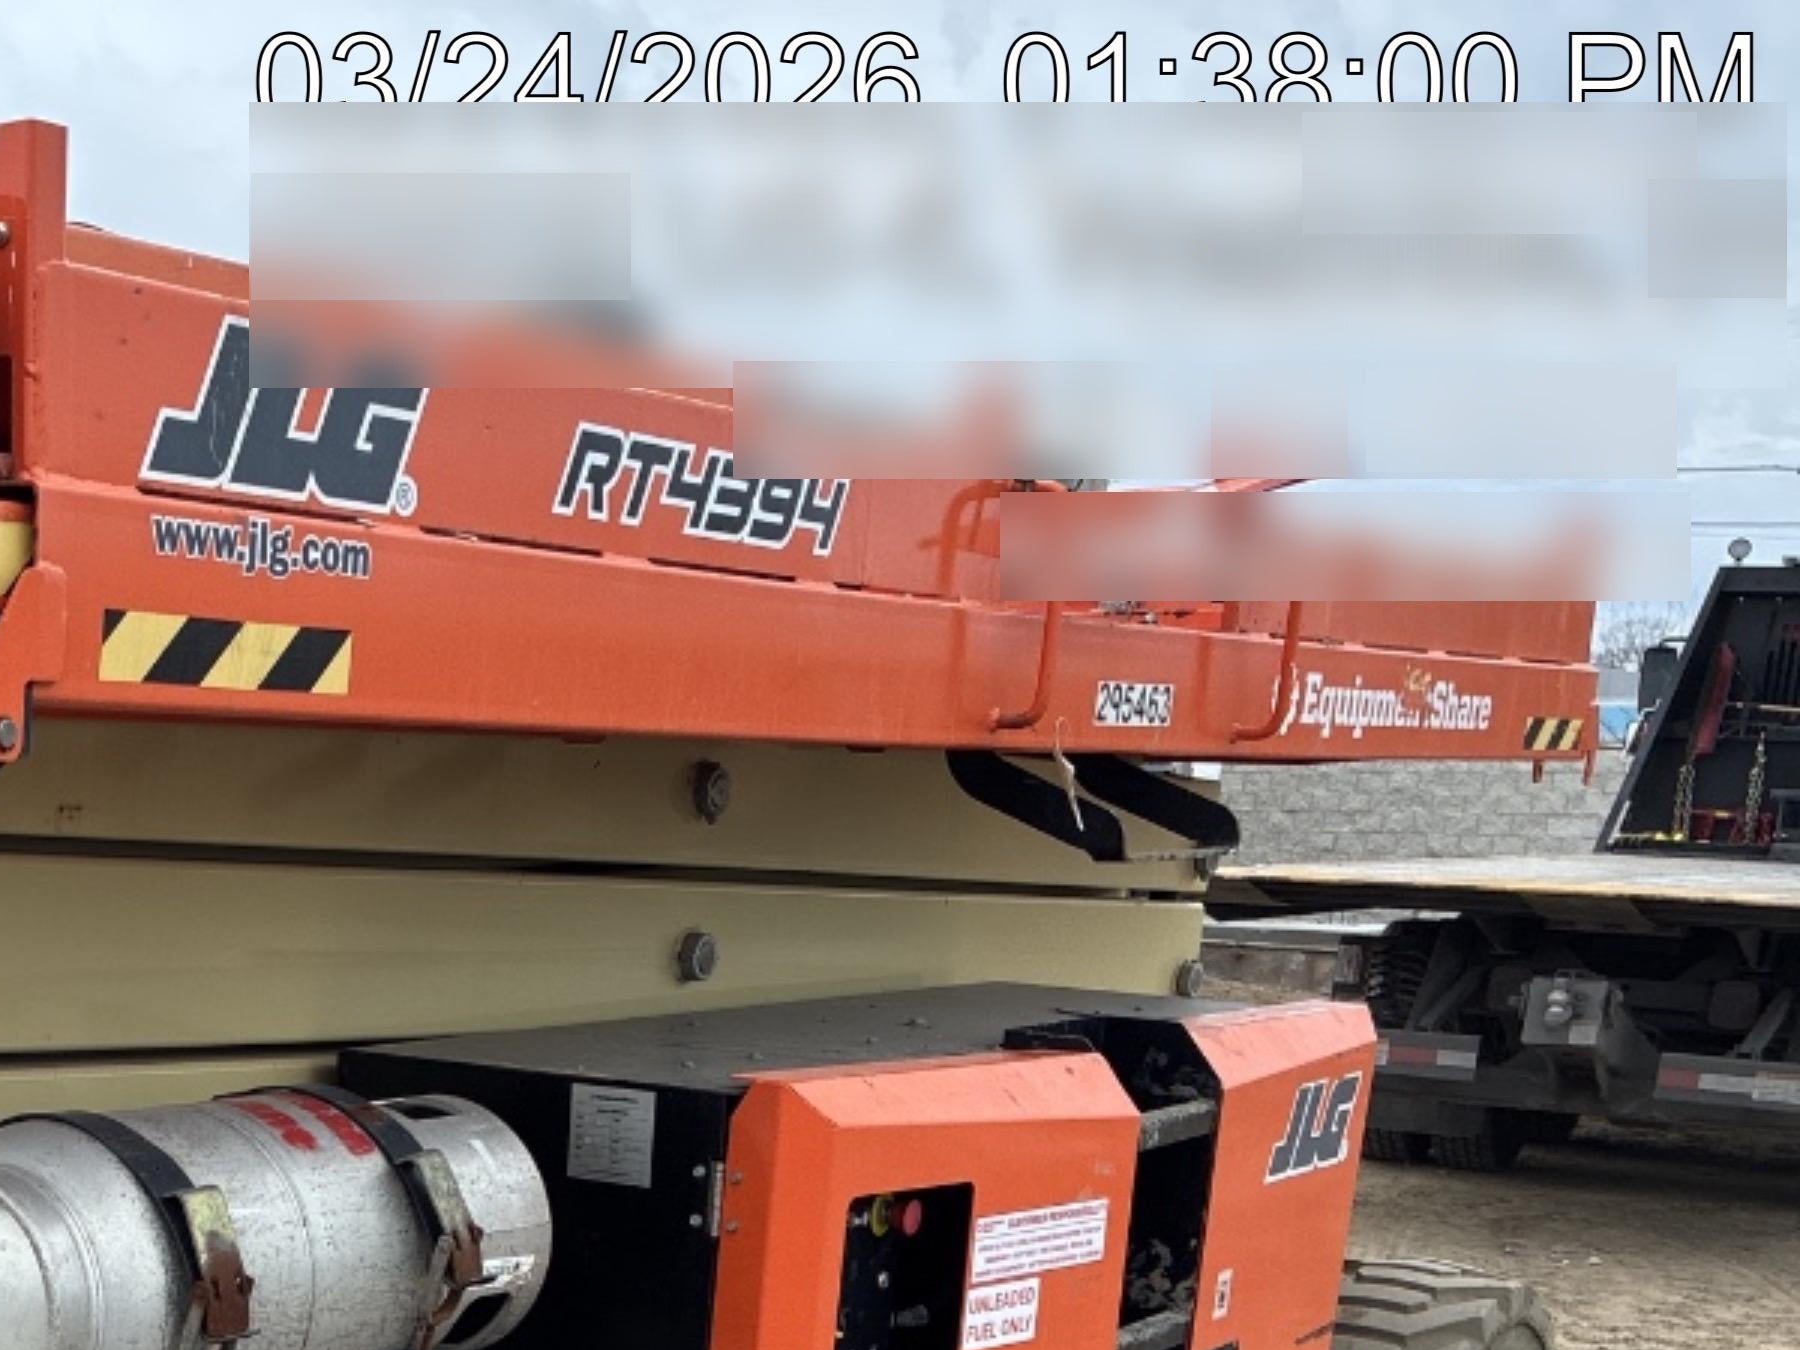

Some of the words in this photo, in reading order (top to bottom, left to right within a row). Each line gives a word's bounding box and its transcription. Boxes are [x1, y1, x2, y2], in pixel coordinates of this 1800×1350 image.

[138, 313, 430, 514] JLG
[551, 420, 851, 557] RT4394
[151, 514, 373, 579] www.jlg.com
[1097, 682, 1171, 724] 295463
[1263, 1070, 1362, 1184] JLG
[966, 1322, 997, 1343] FUEL
[1001, 1313, 1032, 1336] ONLY
[968, 1286, 1035, 1315] UNLEADED
